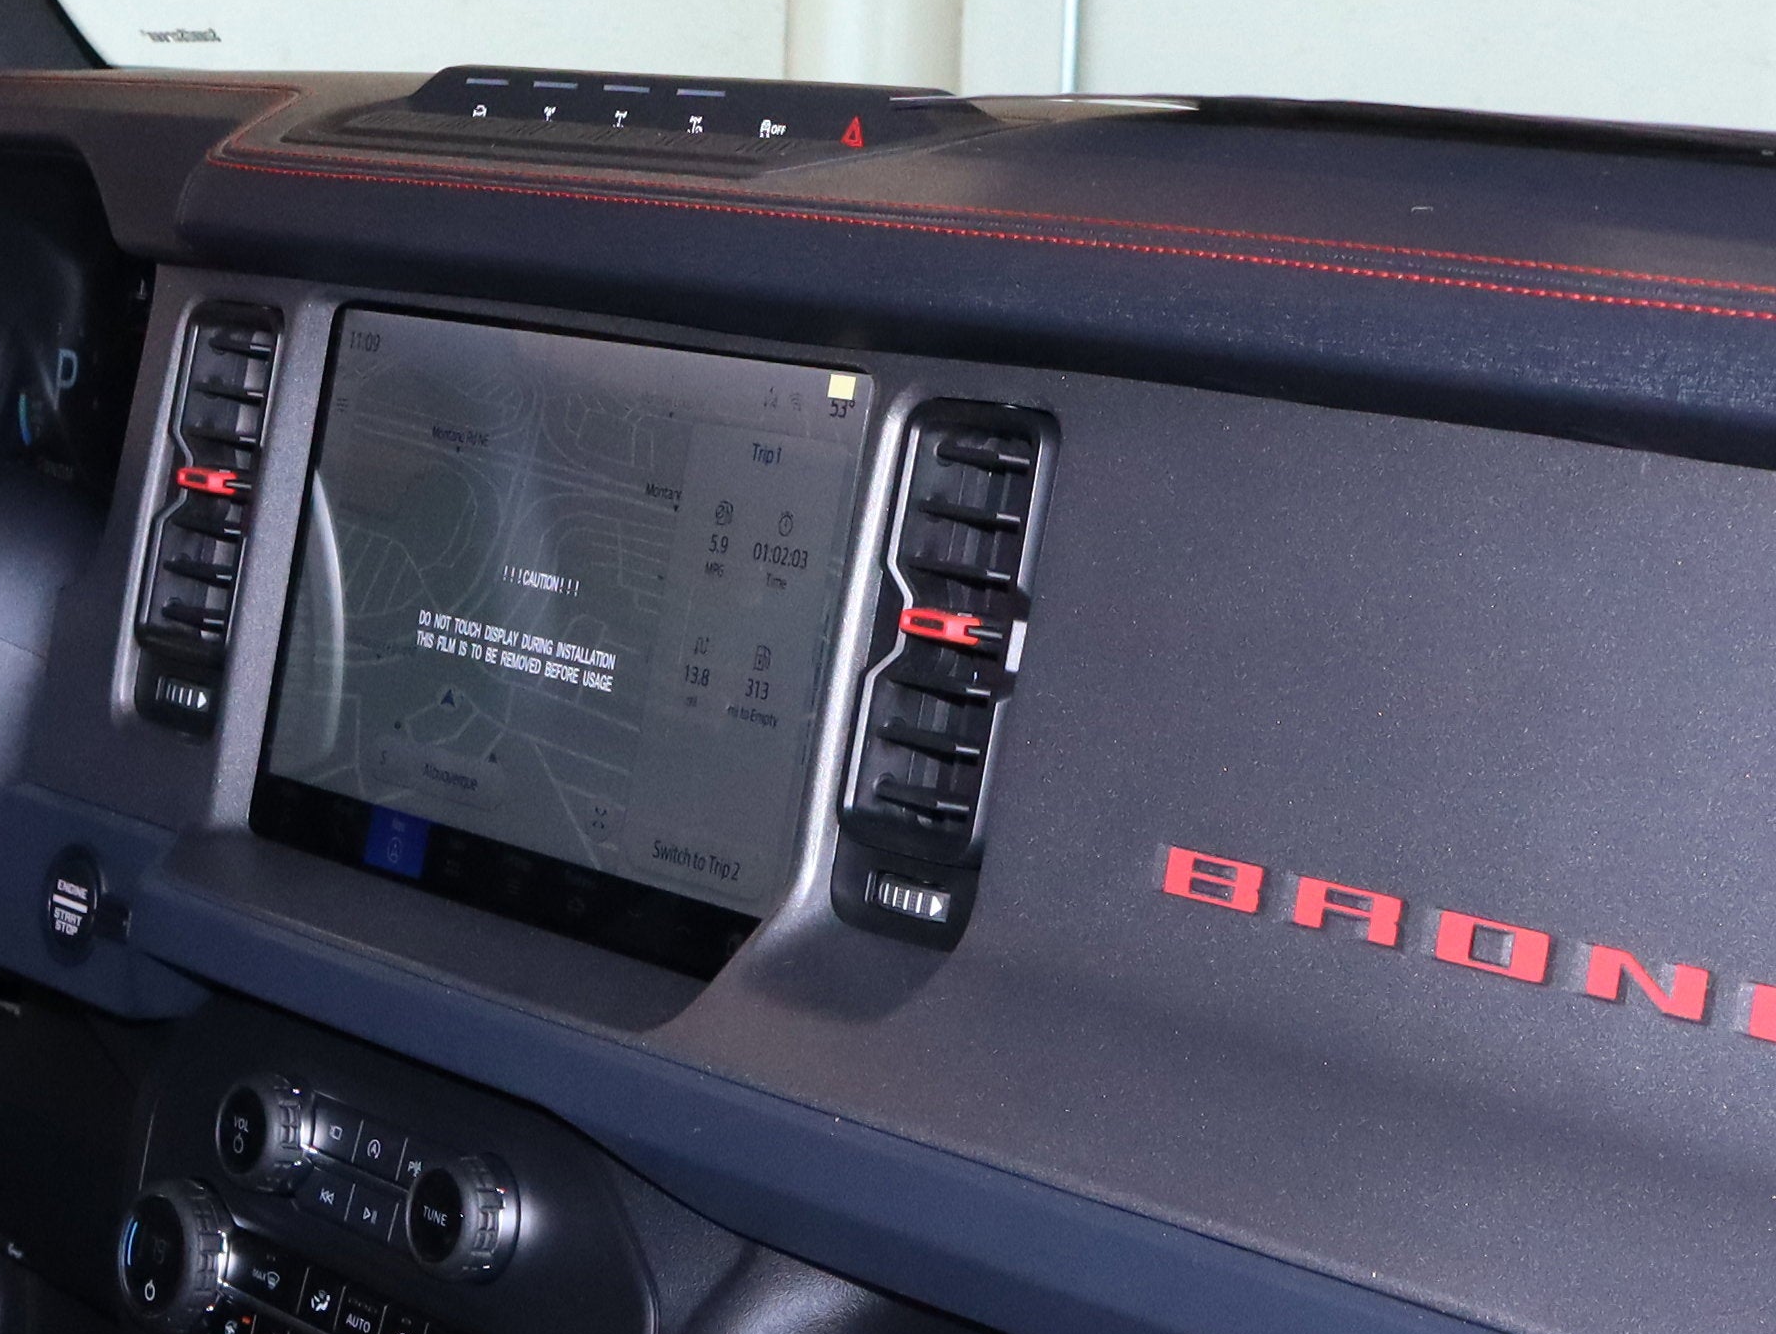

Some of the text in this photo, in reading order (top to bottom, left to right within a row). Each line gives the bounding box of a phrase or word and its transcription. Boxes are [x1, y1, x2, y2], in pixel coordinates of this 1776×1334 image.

[349, 331, 381, 352] 11:09
[752, 443, 773, 465] Trip
[708, 533, 808, 569] 5.9 01:02:03
[418, 609, 617, 670] DO NOT TOUCH DISPLAY DURING INSTALLATION
[416, 630, 614, 693] THIS FILM IS TO BE REMOVED BEFORE USAGE
[684, 664, 770, 700] 13.8 313
[652, 840, 740, 881] Switch to Trip 2
[57, 878, 89, 900] ENGINE
[54, 906, 83, 927] START
[54, 919, 79, 936] STOP
[233, 1115, 249, 1134] VOL
[424, 1204, 447, 1227] TUNE
[345, 1313, 371, 1334] AUTO
